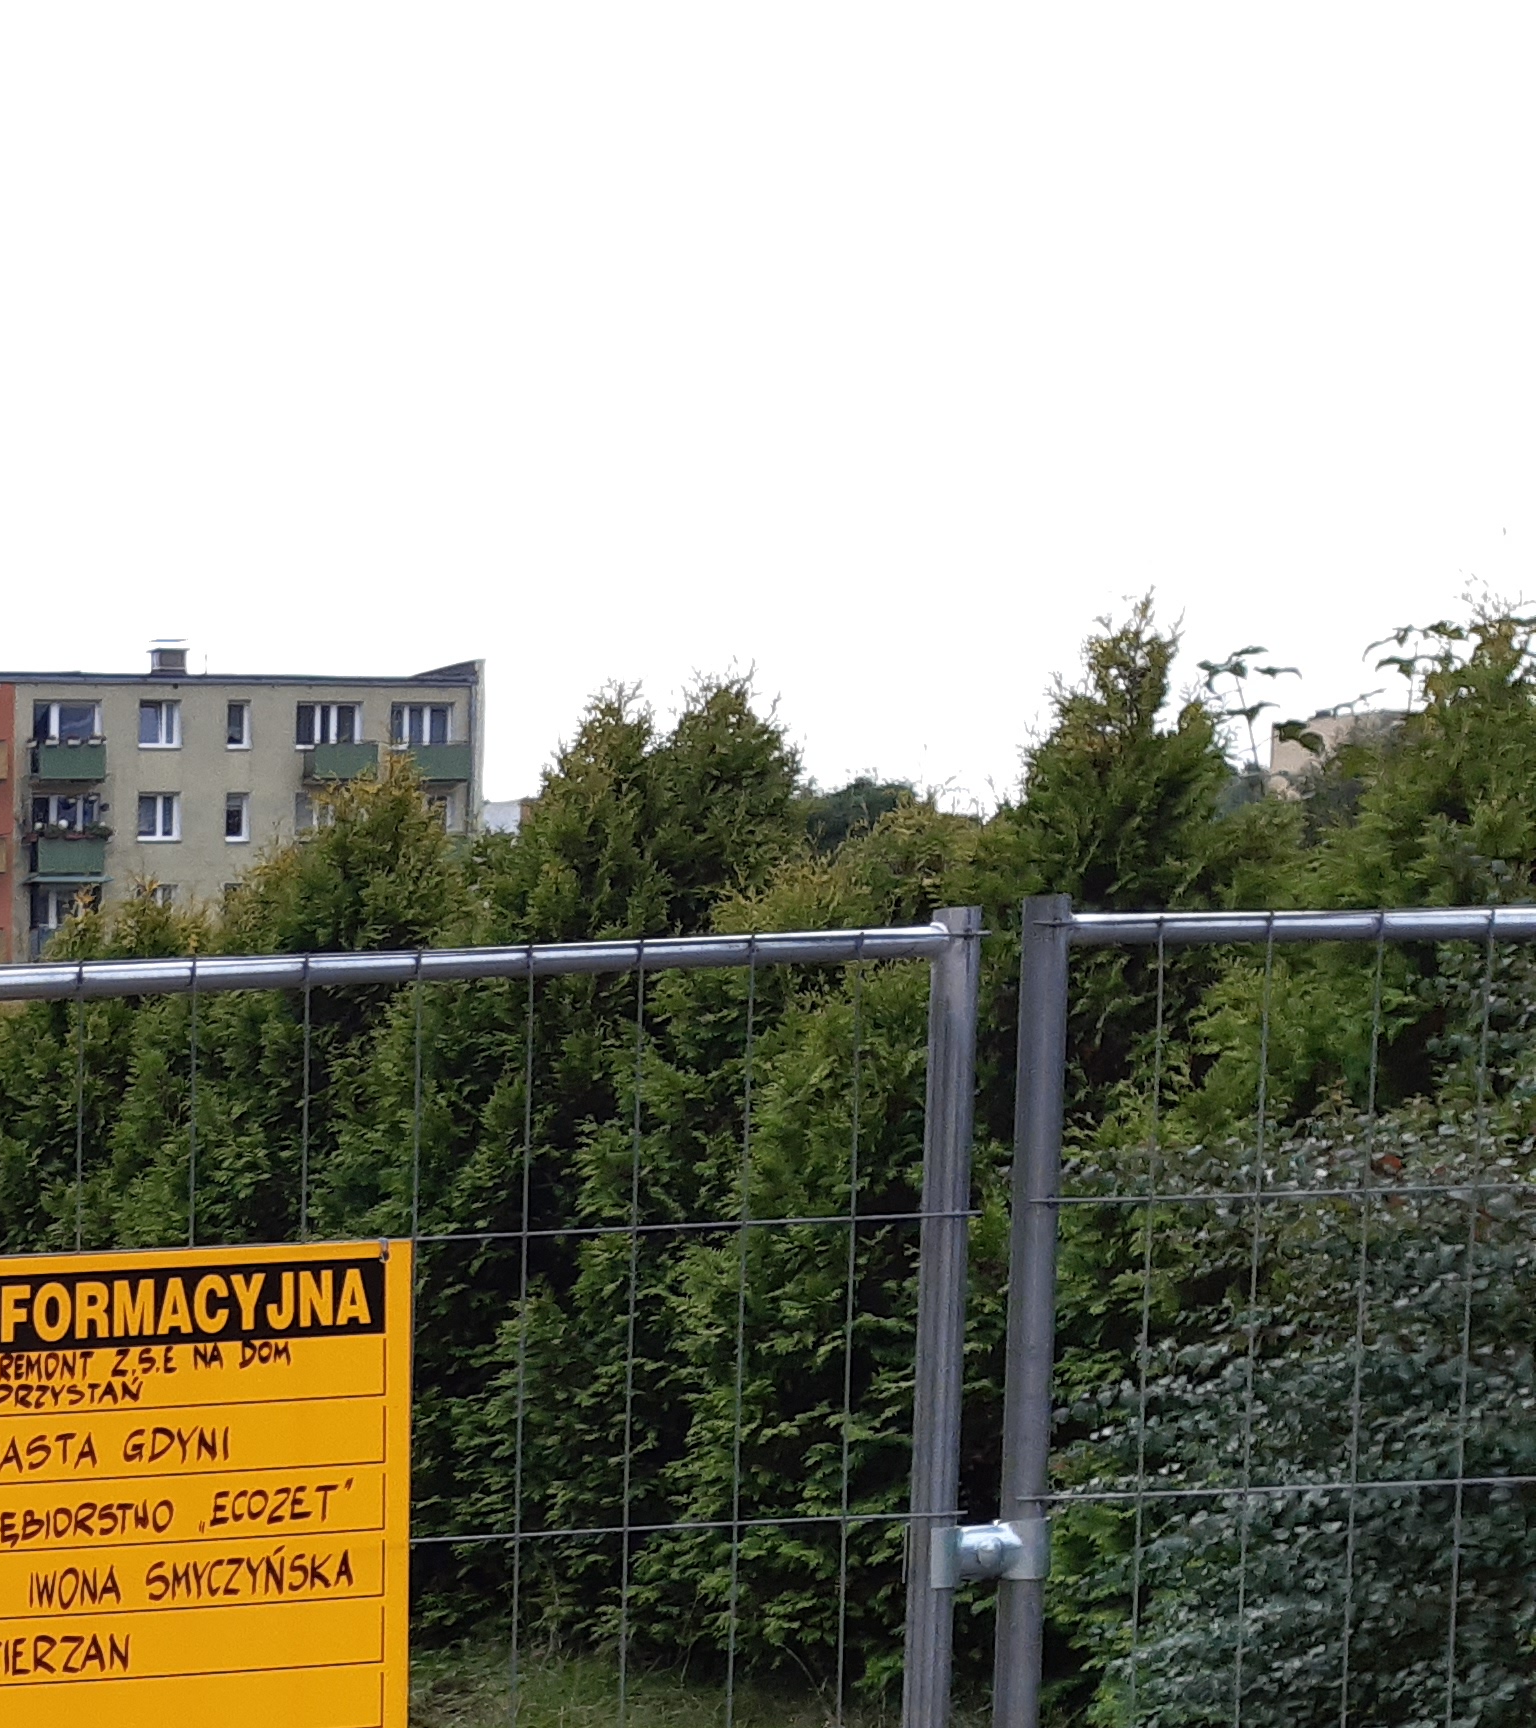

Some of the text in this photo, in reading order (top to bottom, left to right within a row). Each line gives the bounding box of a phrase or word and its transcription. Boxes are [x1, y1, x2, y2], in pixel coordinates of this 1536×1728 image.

[193, 1343, 224, 1369] NA
[240, 1340, 291, 1368] DOM
[123, 1427, 230, 1463] GDYNI
[29, 1564, 120, 1609] IWONA
[145, 1545, 354, 1602] SMYCZYŃSKA
